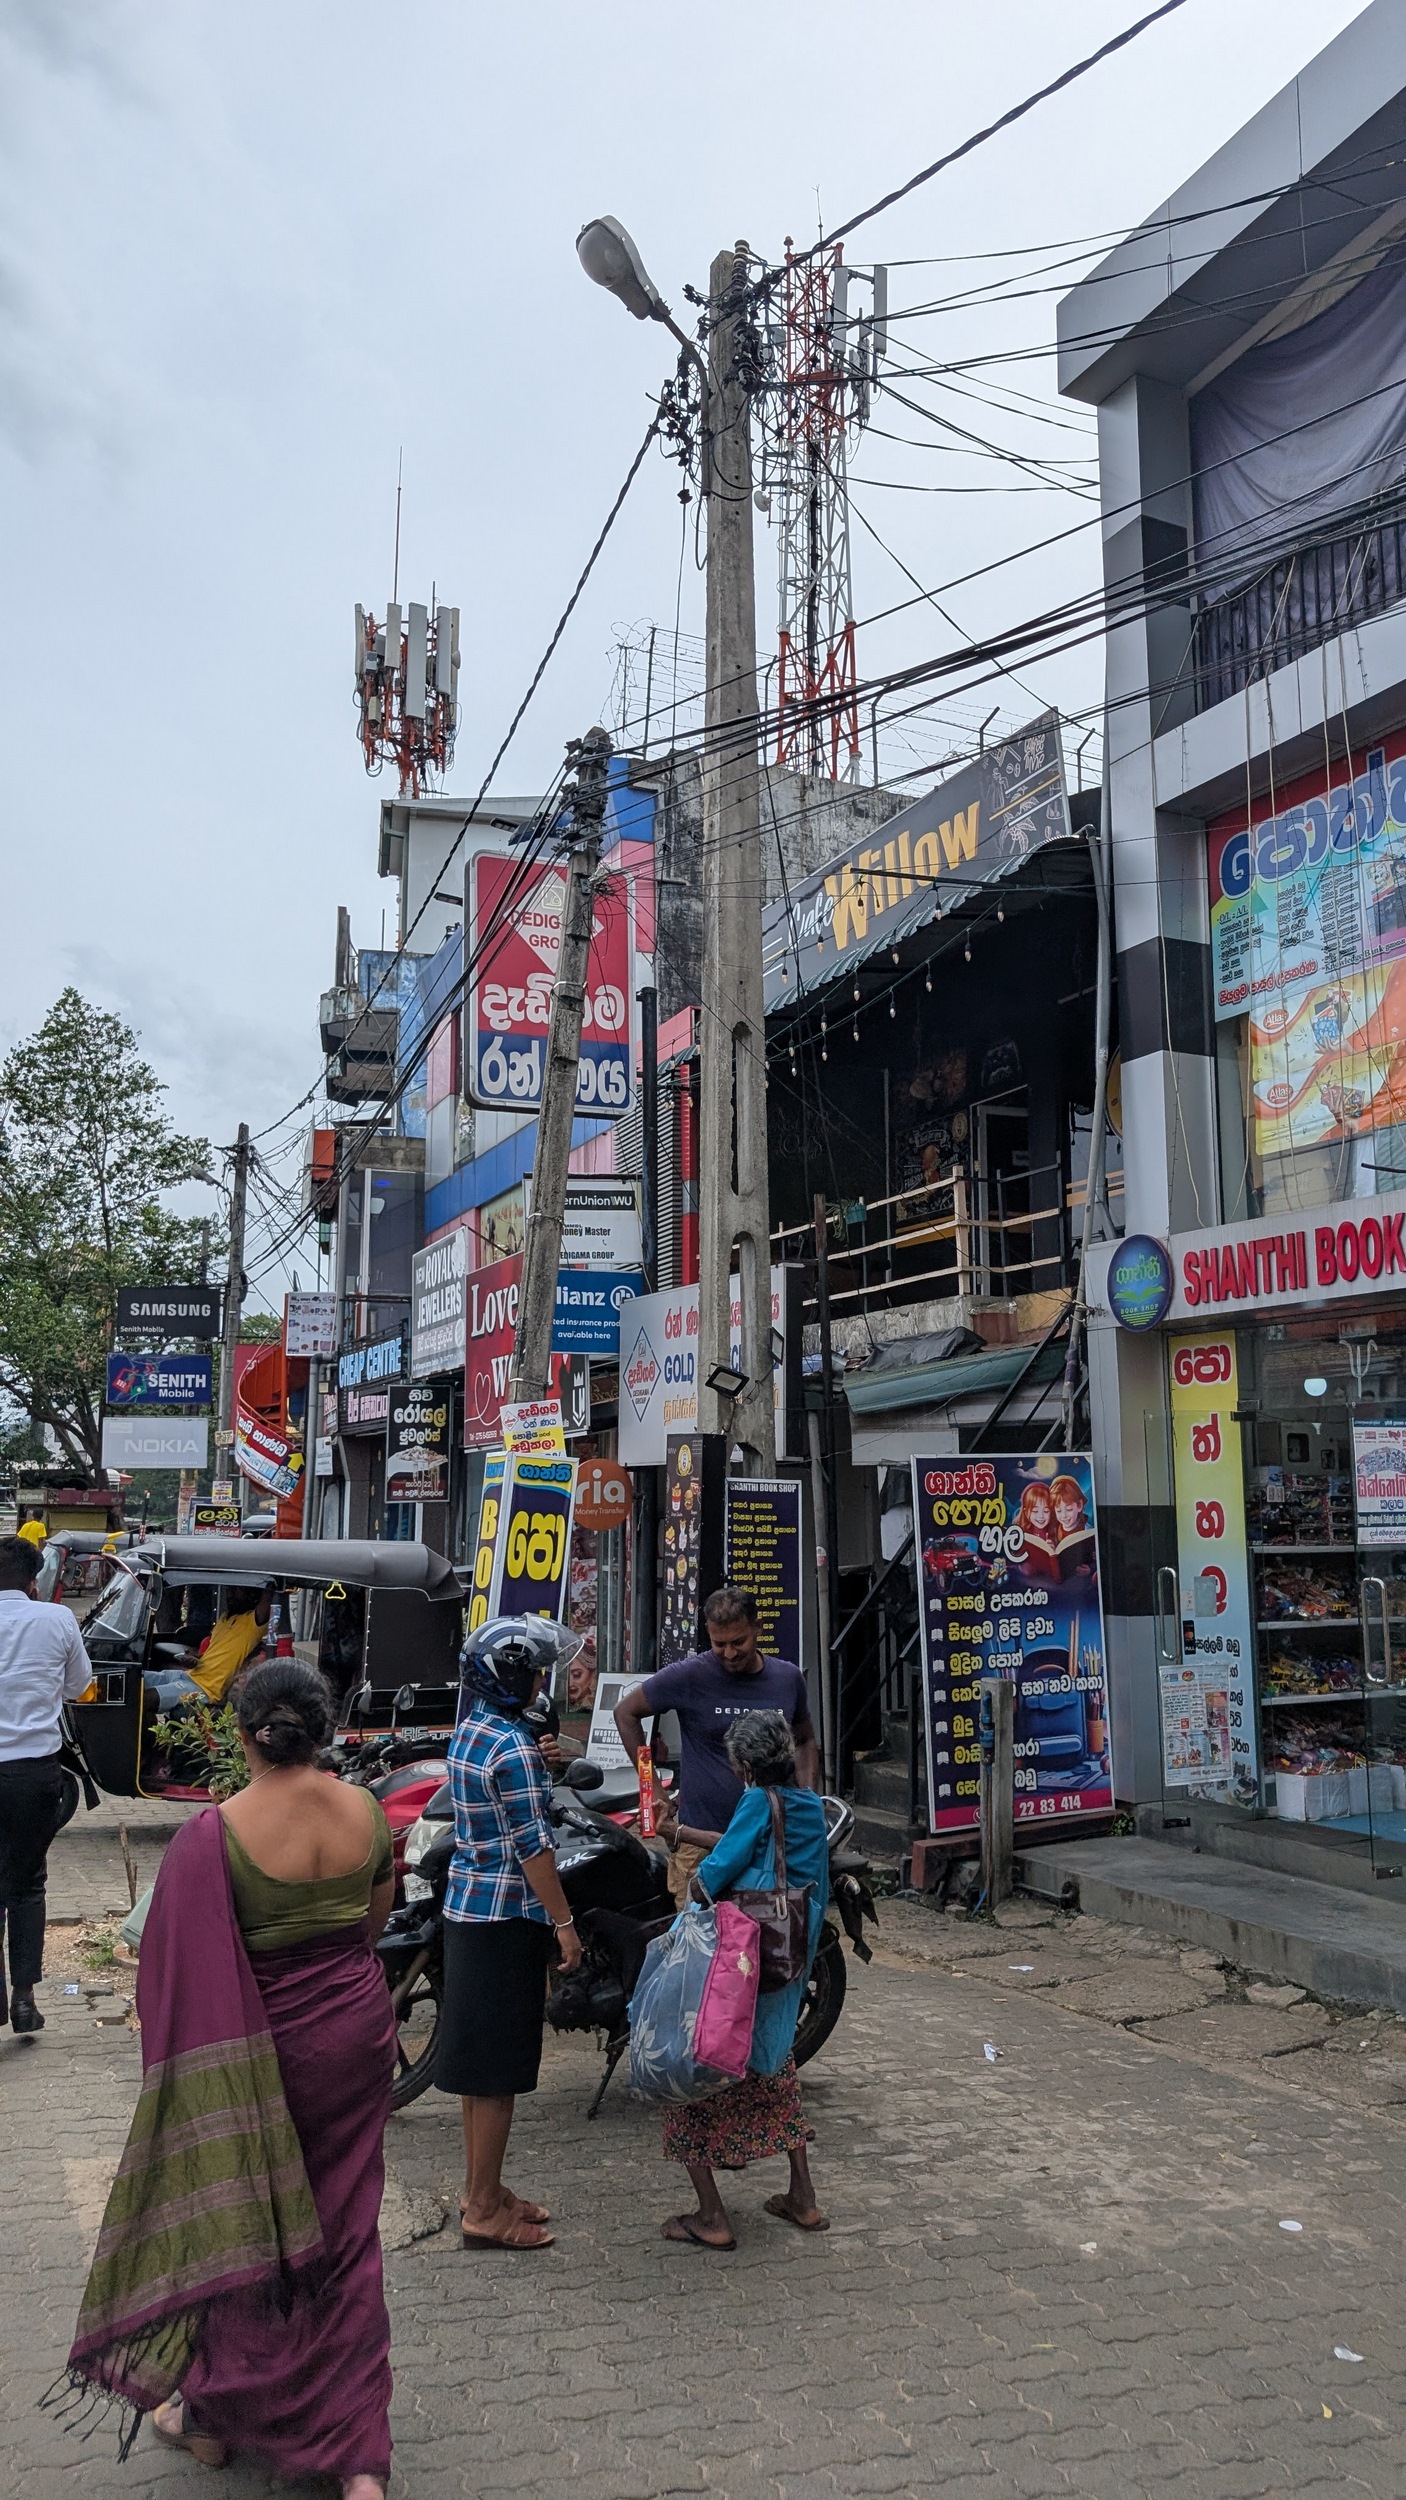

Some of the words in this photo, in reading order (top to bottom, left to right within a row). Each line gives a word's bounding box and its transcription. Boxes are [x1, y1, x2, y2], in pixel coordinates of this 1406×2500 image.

[824, 801, 980, 951] Willow
[481, 1036, 541, 1097] රන්
[562, 1227, 583, 1237] oney
[585, 1227, 611, 1236] Master
[560, 1251, 591, 1260] EDIGAMA
[592, 1251, 615, 1260] GROUP
[1183, 1231, 1308, 1306] SHANTHI
[1314, 1212, 1406, 1286] BOOK
[425, 1245, 452, 1290] ROYAL
[417, 1281, 462, 1329] JEWELLERS
[556, 1285, 606, 1306] lianz
[130, 1302, 211, 1317] SAMSUNG
[120, 1325, 142, 1333] Senith
[142, 1325, 165, 1333] Mobile
[566, 1319, 602, 1327] insurance
[558, 1331, 593, 1339] available
[594, 1331, 611, 1339] here
[339, 1350, 365, 1388] CHEAP
[366, 1337, 402, 1381] CENTRE
[664, 1352, 695, 1385] GOLD
[148, 1373, 207, 1388] SENITH
[158, 1388, 195, 1398] Mobile
[408, 1389, 434, 1402] නිව්
[393, 1403, 447, 1428] රෝයල්
[517, 1402, 559, 1420] දැඩිගම
[523, 1419, 537, 1429] රන්
[124, 1438, 200, 1453] NOKIA
[399, 1427, 441, 1446] ජුවලර්ස්
[518, 1463, 573, 1480] ශාන්ති
[925, 1462, 997, 1496] ශාන්ති
[576, 1468, 625, 1504] ria
[759, 1483, 778, 1492] BOOK
[778, 1484, 797, 1493] SHOP
[575, 1507, 598, 1516] Money
[598, 1507, 625, 1515] Transfer
[933, 1482, 1007, 1526] පොත්
[979, 1525, 1029, 1563] හල
[946, 1595, 986, 1613] පාසල්
[990, 1588, 1049, 1613] උපකරණ
[948, 1621, 994, 1644] සියලුම
[998, 1617, 1021, 1643] ලිපි
[1225, 1638, 1241, 1657] බඩු
[988, 1649, 1024, 1669] පොත්
[1021, 1679, 1045, 1697] සහ
[1049, 1674, 1071, 1693] නව
[1076, 1675, 1103, 1691] කතා
[594, 1729, 621, 1738] WESTER
[953, 1714, 975, 1738] බුදු
[1014, 1767, 1037, 1791] බඩු
[1019, 1801, 1035, 1817] 22
[1040, 1799, 1056, 1814] 83
[1061, 1795, 1082, 1810] 414
